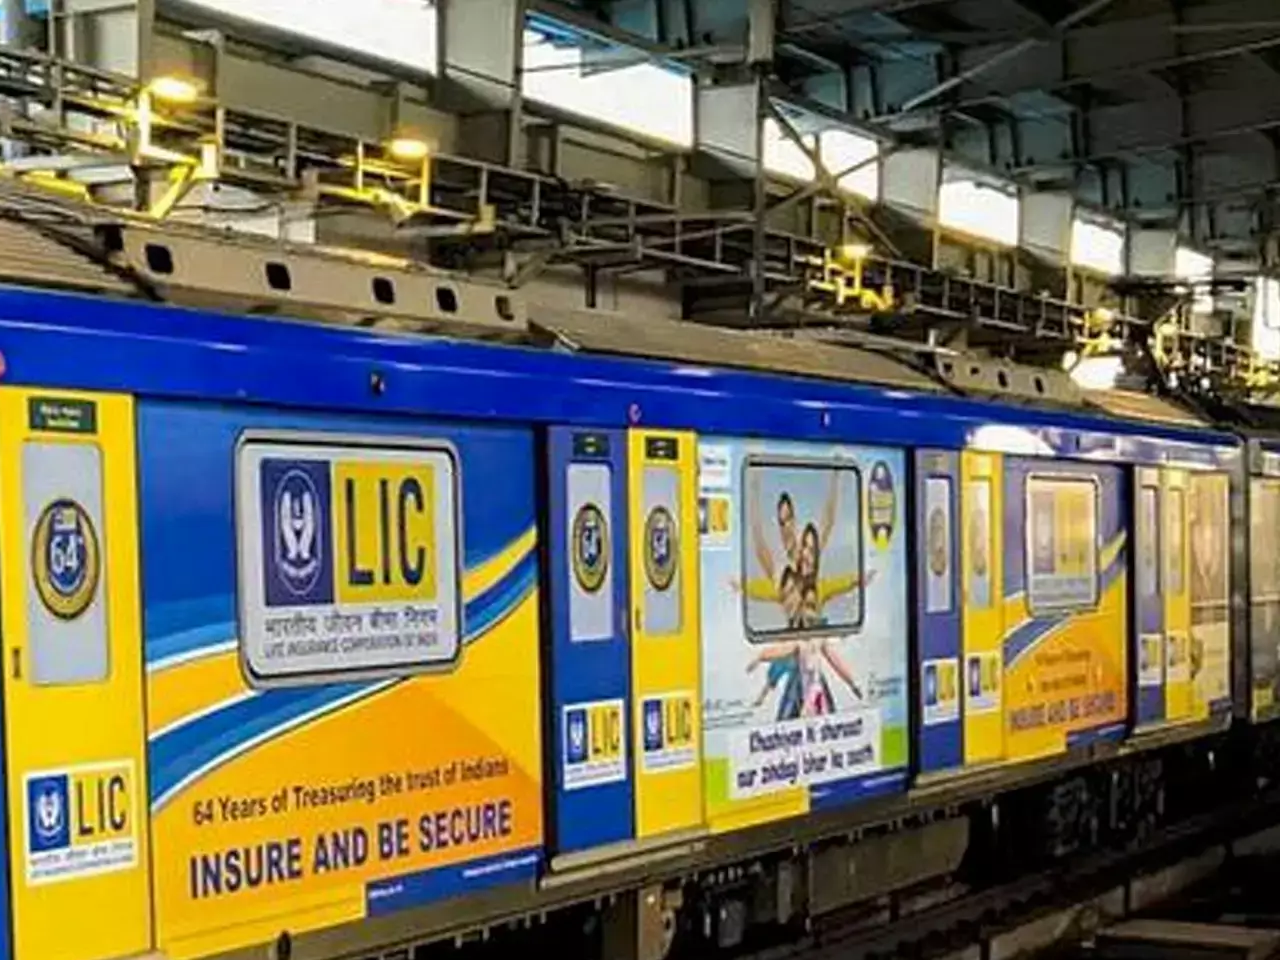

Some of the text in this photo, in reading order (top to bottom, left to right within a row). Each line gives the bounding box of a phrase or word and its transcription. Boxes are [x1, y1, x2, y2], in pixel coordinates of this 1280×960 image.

[346, 477, 425, 585] LIC
[76, 775, 127, 836] LIC
[193, 756, 510, 826] 64 Years of Treasuring the trust of Indians
[191, 837, 302, 899] INSURE
[313, 825, 369, 875] AND
[378, 818, 410, 860] BE
[419, 799, 512, 852] SECURE
